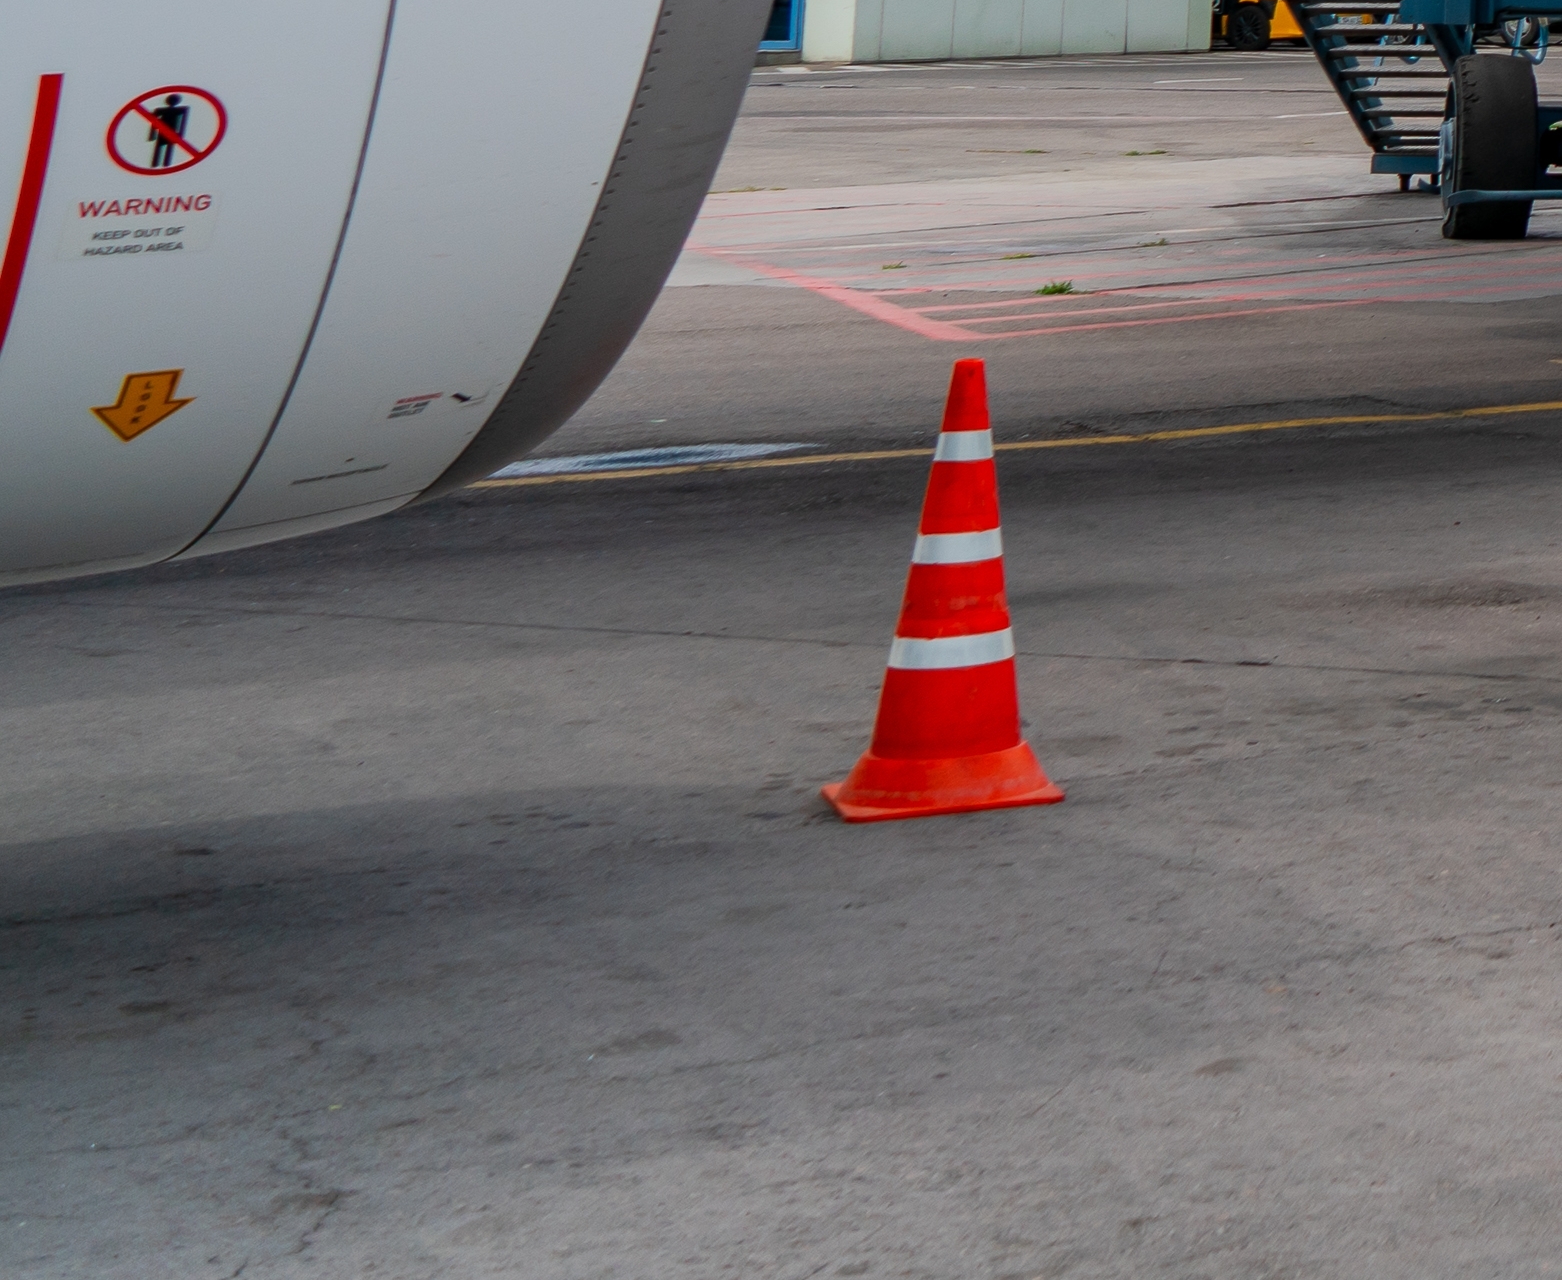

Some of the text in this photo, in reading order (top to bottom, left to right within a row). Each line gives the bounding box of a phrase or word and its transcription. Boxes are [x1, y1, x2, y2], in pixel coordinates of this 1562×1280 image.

[78, 193, 213, 219] WARNING
[92, 226, 186, 240] KEEP OUT OF
[83, 242, 184, 257] HAZARD AREA
